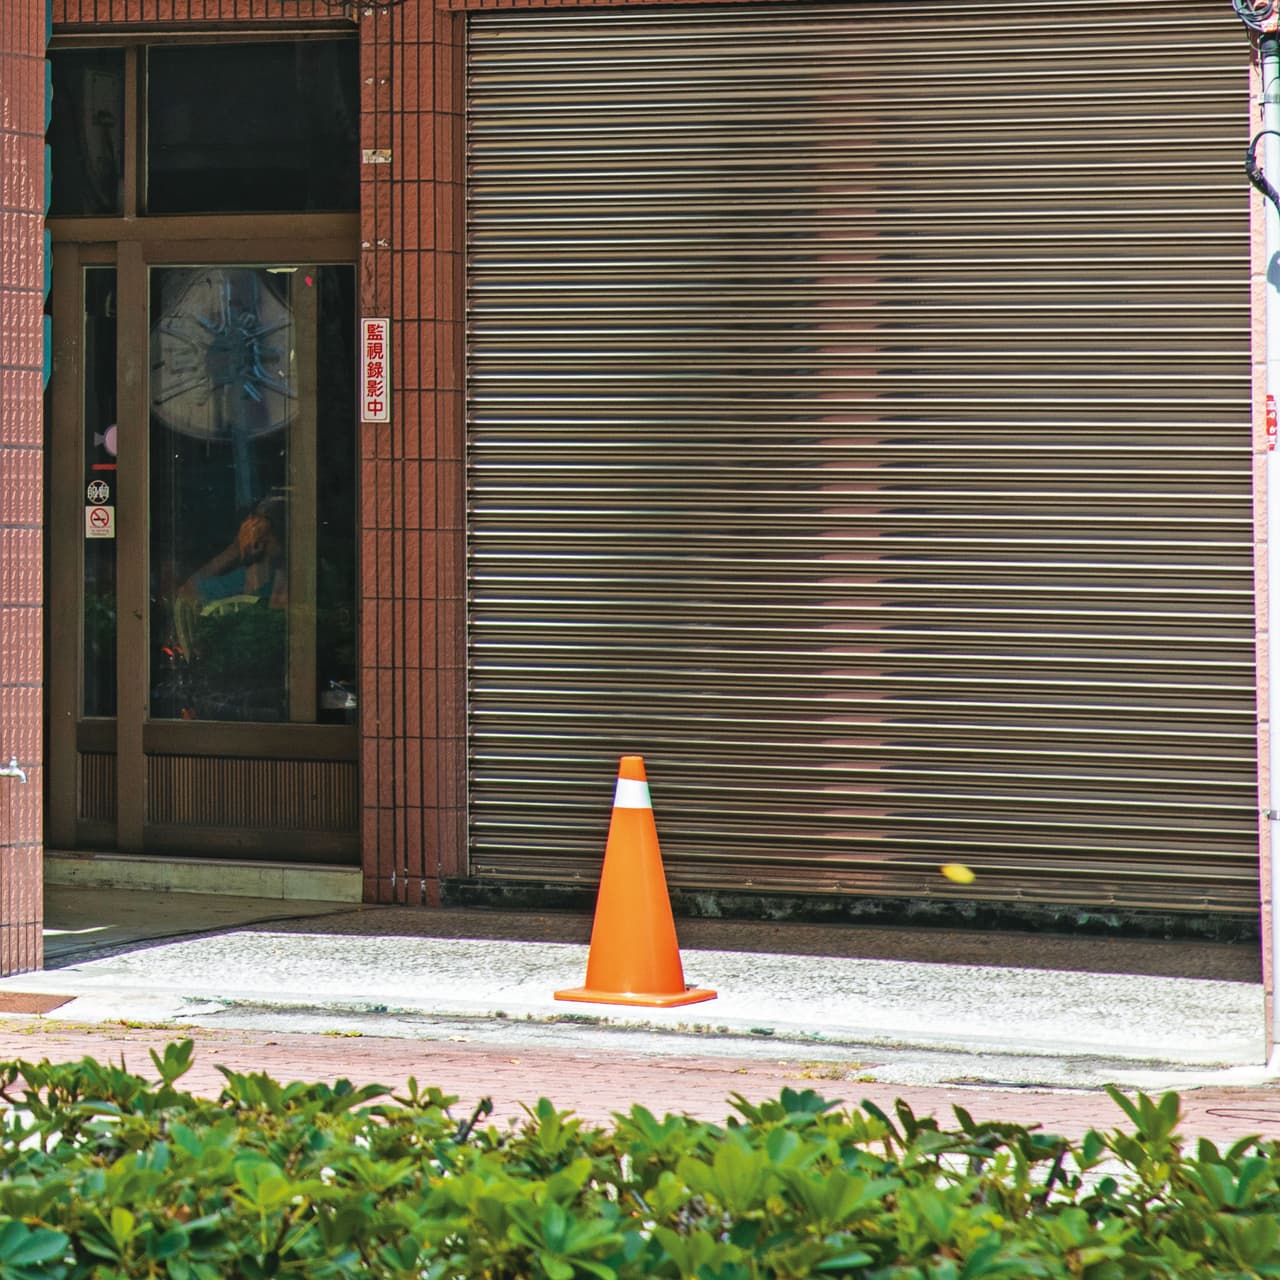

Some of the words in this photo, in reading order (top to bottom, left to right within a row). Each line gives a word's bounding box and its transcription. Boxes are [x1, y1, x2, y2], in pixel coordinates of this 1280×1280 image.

[366, 323, 385, 417] 監視錄影中
